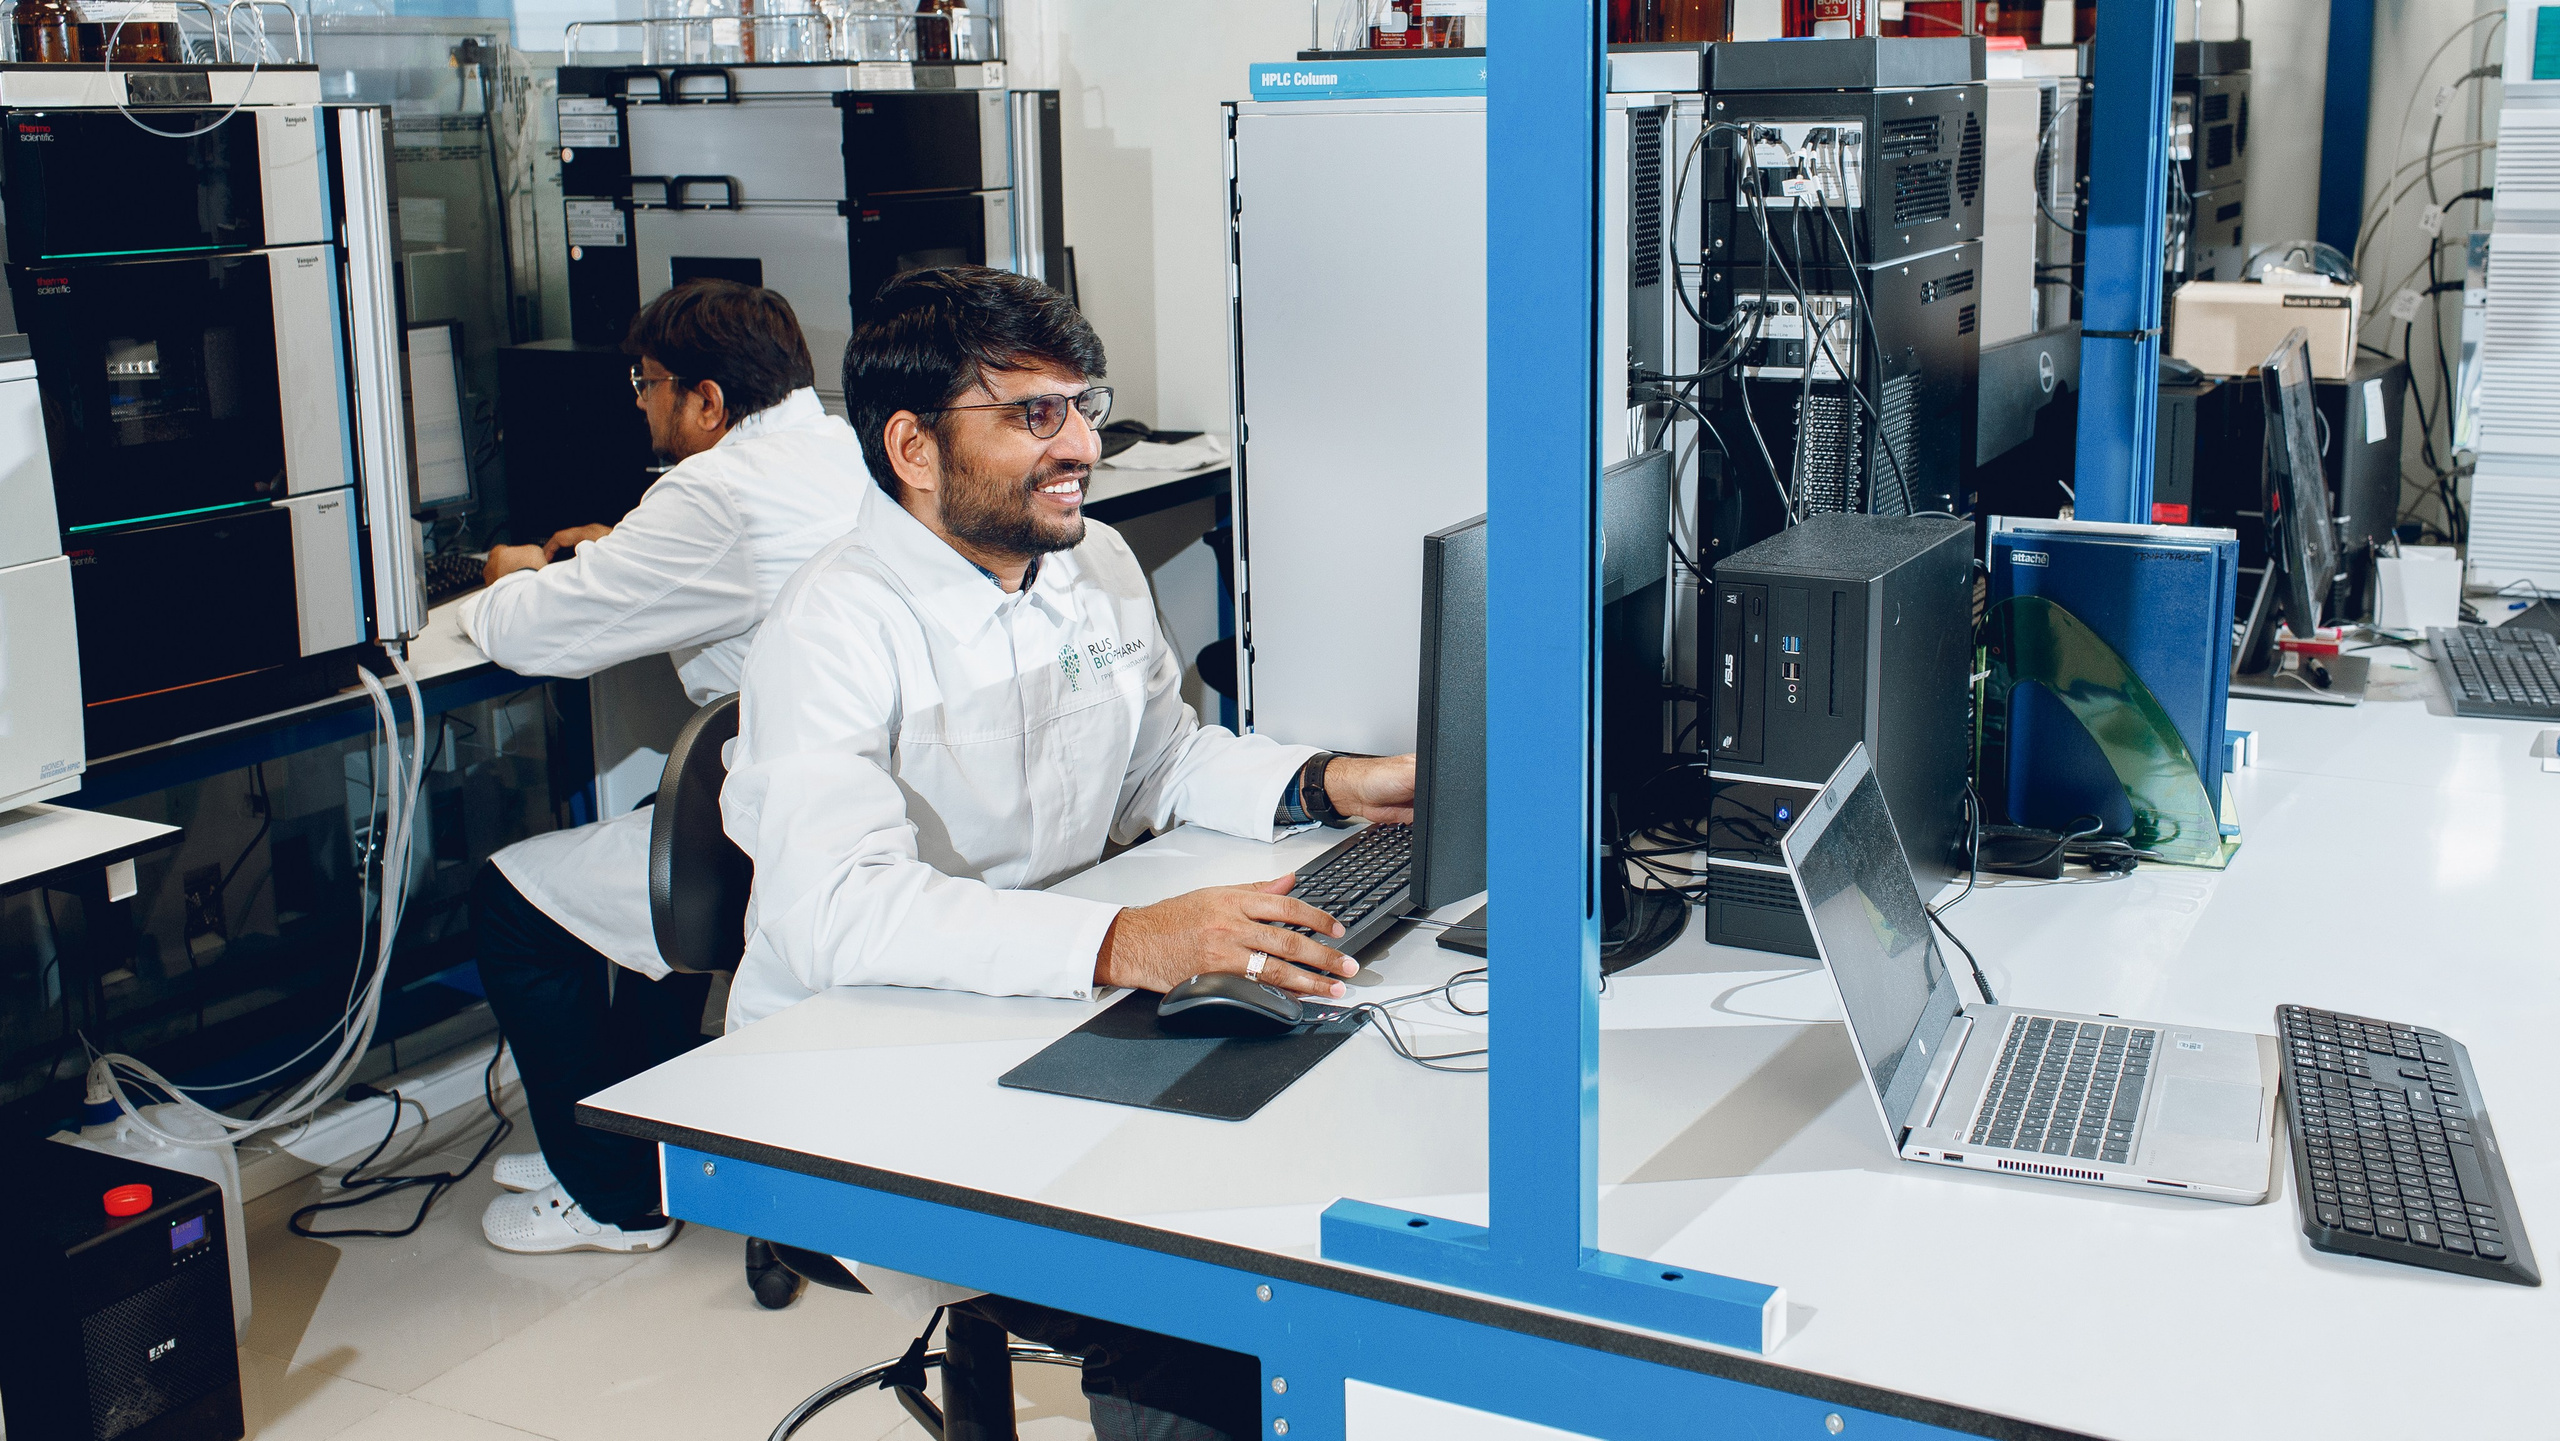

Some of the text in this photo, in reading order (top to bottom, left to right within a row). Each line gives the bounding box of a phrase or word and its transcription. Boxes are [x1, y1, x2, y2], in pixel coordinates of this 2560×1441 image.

[1824, 6, 1839, 14] 3.3
[986, 67, 1000, 84] 34
[1261, 71, 1338, 87] HPLC Column
[19, 123, 51, 133] thermo
[20, 133, 55, 142] scientific
[36, 277, 69, 287] thermo
[71, 556, 97, 567] cientific
[2011, 552, 2047, 565] attaché
[1087, 637, 1113, 656] RUS
[1724, 653, 1734, 688] ASUS
[41, 760, 65, 773] DIONEX
[149, 1338, 176, 1359] EATON
